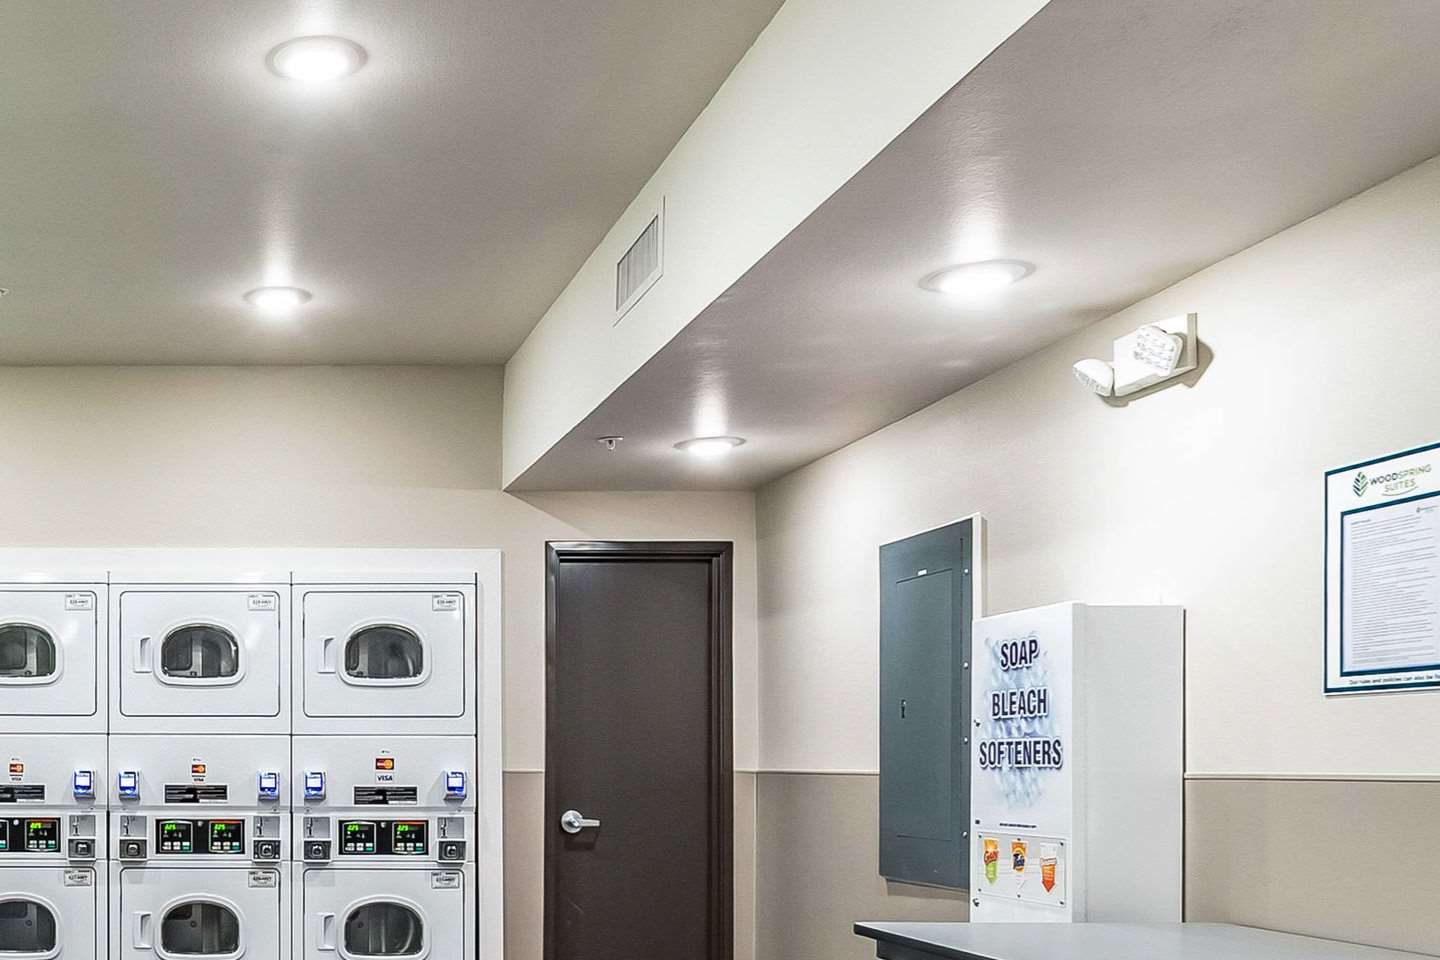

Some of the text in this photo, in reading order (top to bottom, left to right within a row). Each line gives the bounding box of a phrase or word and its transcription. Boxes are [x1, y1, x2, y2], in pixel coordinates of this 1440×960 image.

[1369, 464, 1432, 485] WOODSPRING
[1385, 479, 1416, 492] SUITES
[1000, 639, 1038, 668] SOAP
[991, 688, 1047, 717] BLEACH
[979, 738, 1062, 766] SOFTENERS
